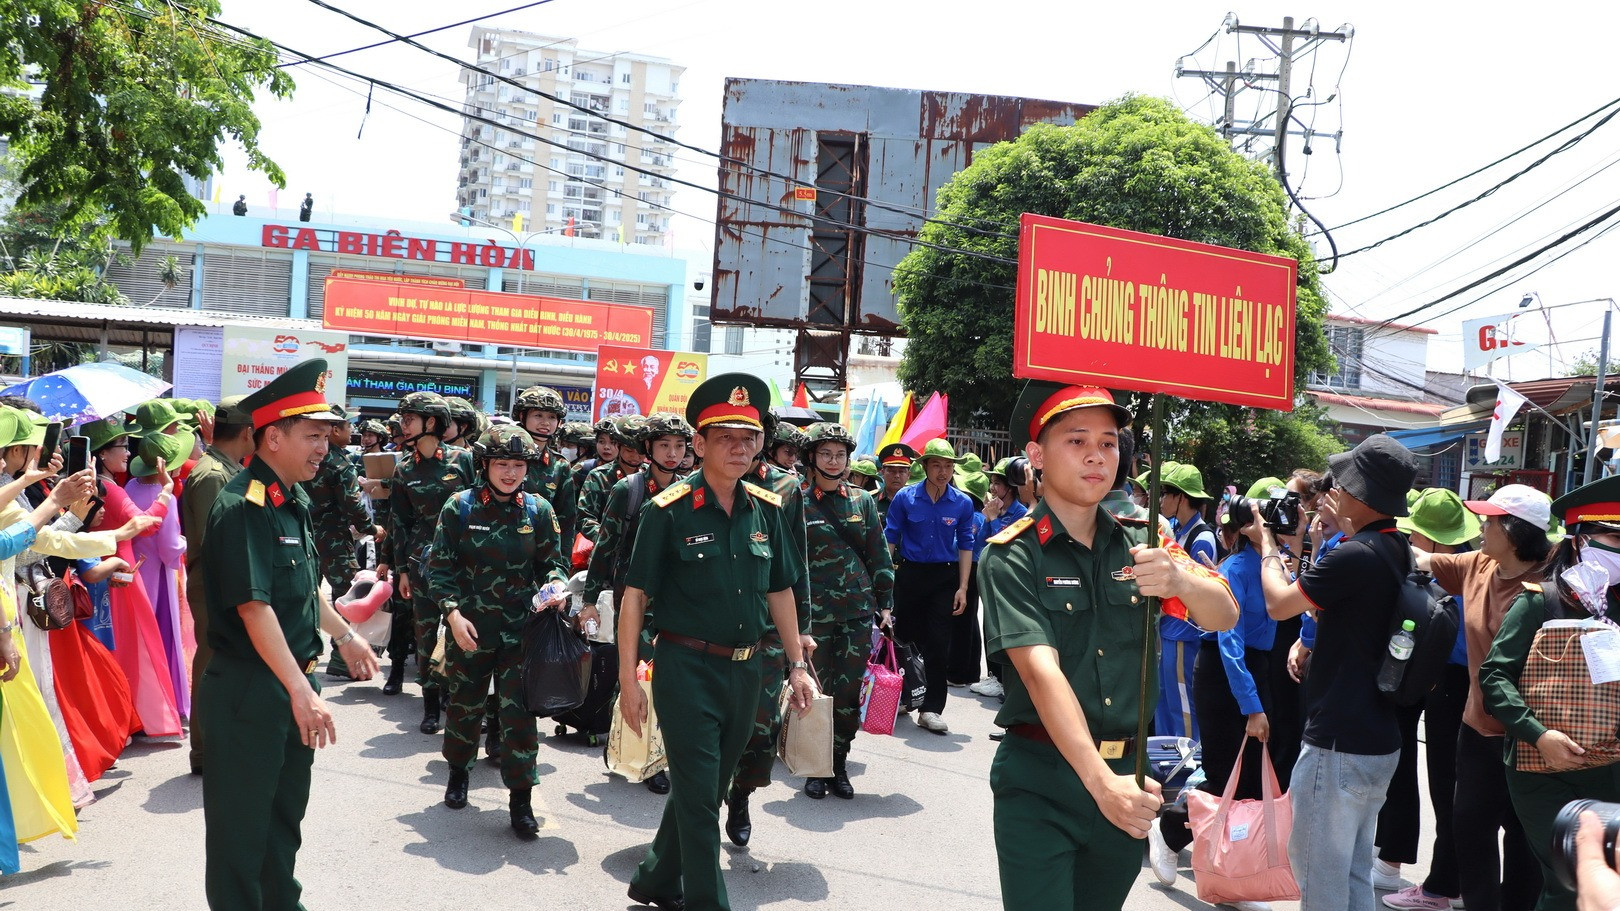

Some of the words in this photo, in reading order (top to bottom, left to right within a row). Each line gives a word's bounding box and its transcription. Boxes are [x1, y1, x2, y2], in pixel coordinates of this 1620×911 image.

[262, 224, 320, 251] GA
[338, 229, 436, 262] BIÊN
[451, 239, 534, 270] HÒA
[388, 296, 405, 307] VINH
[492, 306, 510, 316] THAM
[511, 308, 522, 318] GIA
[364, 310, 374, 319] 50
[1035, 268, 1077, 337] BINH
[1080, 256, 1135, 345] CHỦNG
[1139, 273, 1189, 352] THÔNG
[1193, 292, 1217, 356] TIN
[1220, 285, 1253, 361] LIÊN
[1256, 302, 1283, 378] LẠC
[237, 364, 249, 376] ĐẠI
[252, 362, 274, 375] THẮNG
[277, 364, 291, 376] MÙ
[248, 377, 262, 388] SỨC
[364, 378, 394, 390] THAM
[396, 380, 415, 392] GIA
[567, 390, 589, 402] VÀO
[600, 388, 624, 399] 30/4
[1503, 438, 1519, 448] XE
